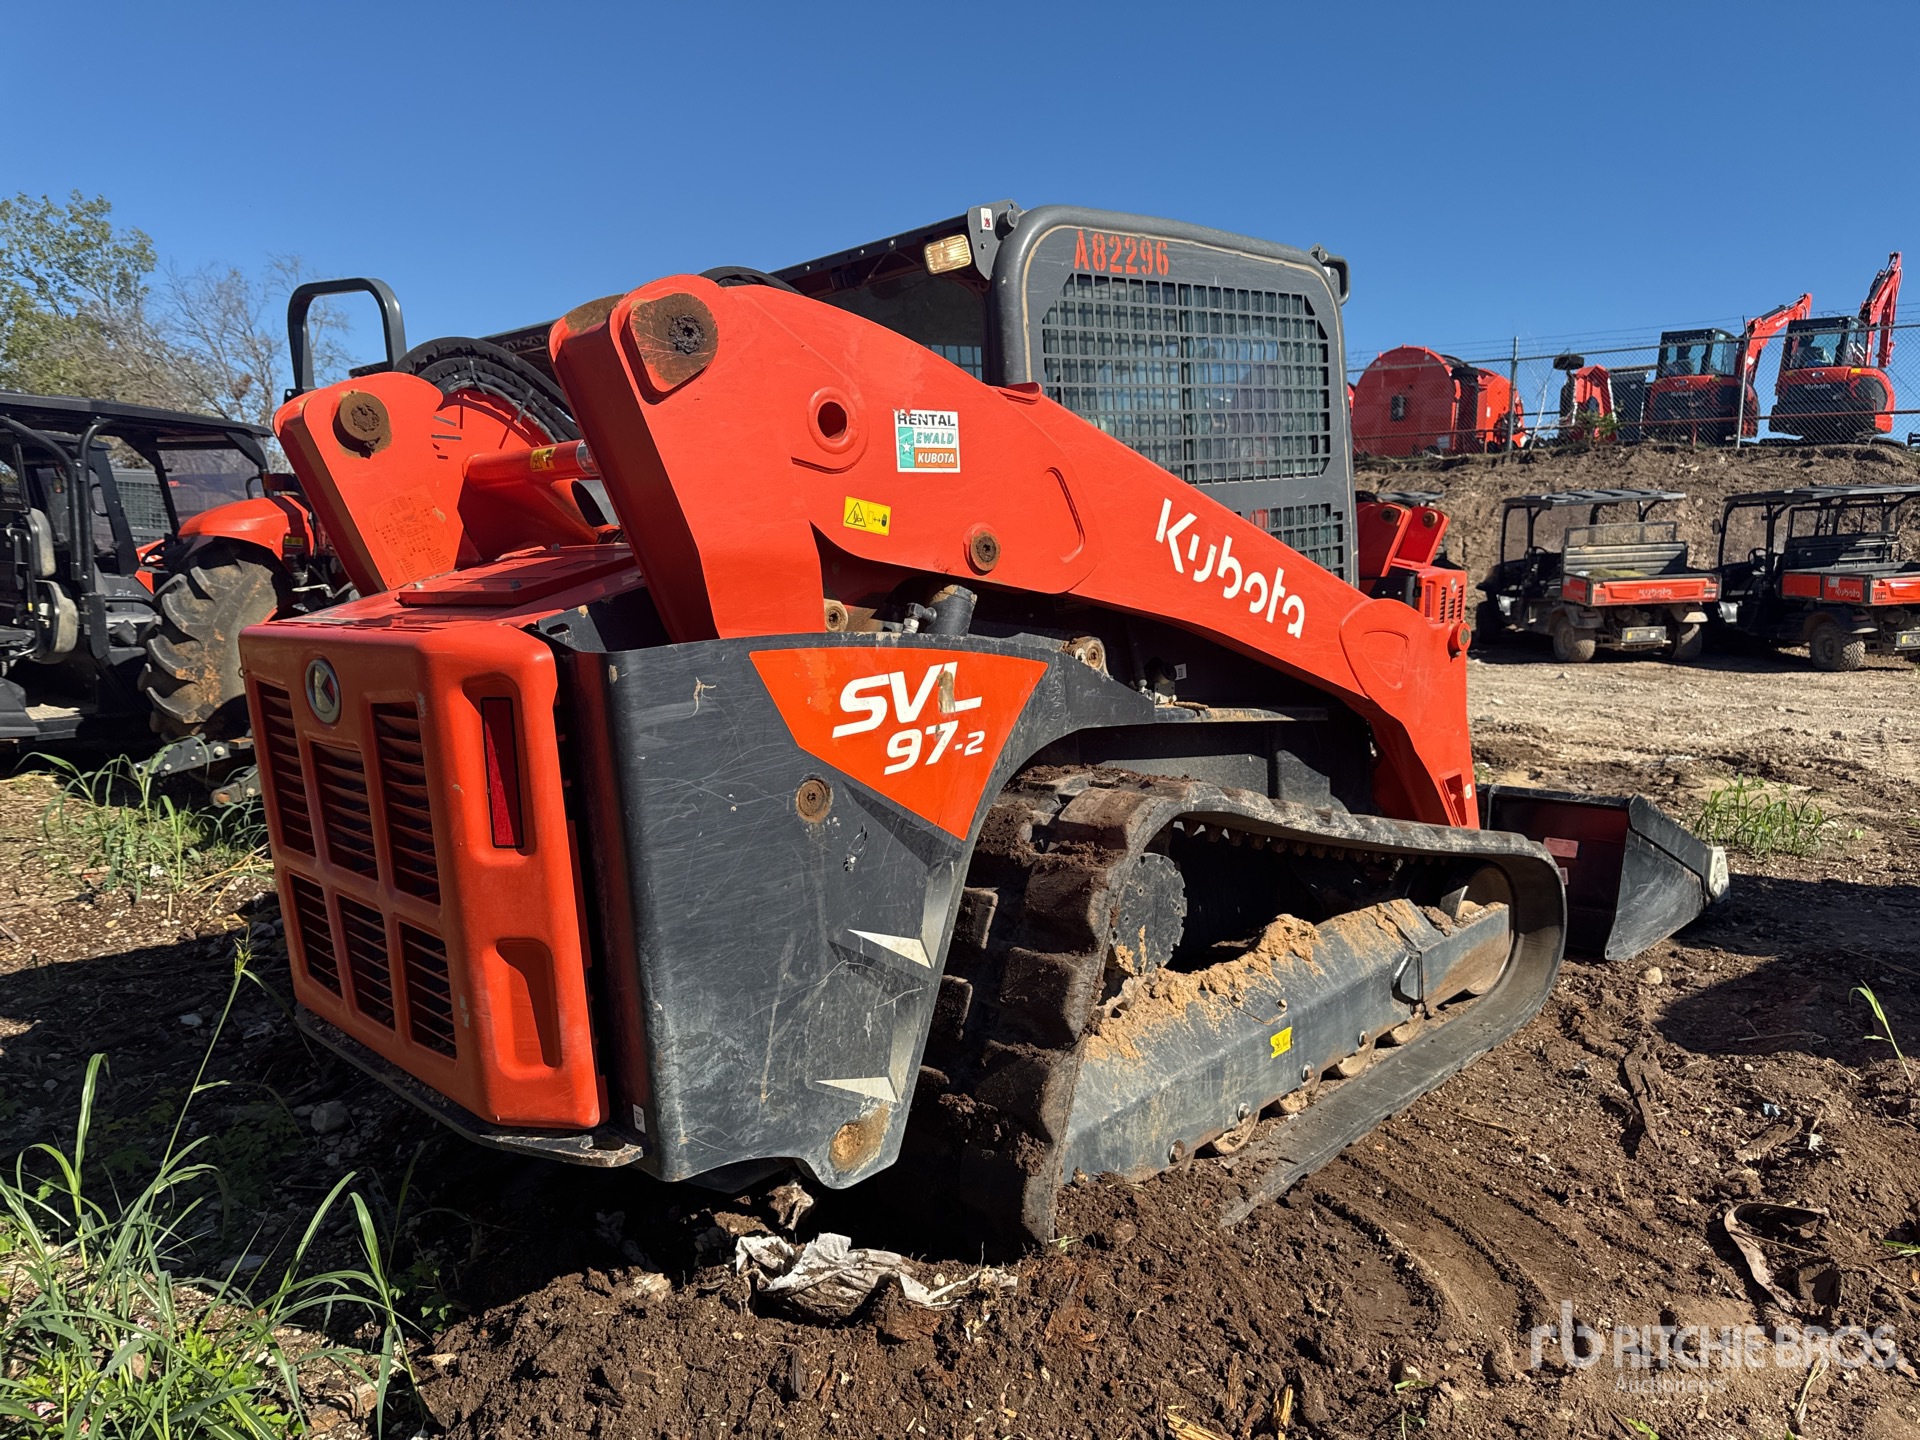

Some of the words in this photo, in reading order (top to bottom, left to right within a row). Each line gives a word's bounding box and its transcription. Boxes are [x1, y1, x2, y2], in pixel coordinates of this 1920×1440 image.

[1073, 230, 1169, 276] A82296
[897, 413, 956, 427] RENTAL
[916, 431, 955, 445] EWALD
[917, 452, 955, 464] KUBOTA
[1155, 498, 1306, 638] Kubota
[831, 661, 983, 739] SVL
[883, 719, 986, 776] 97-2
